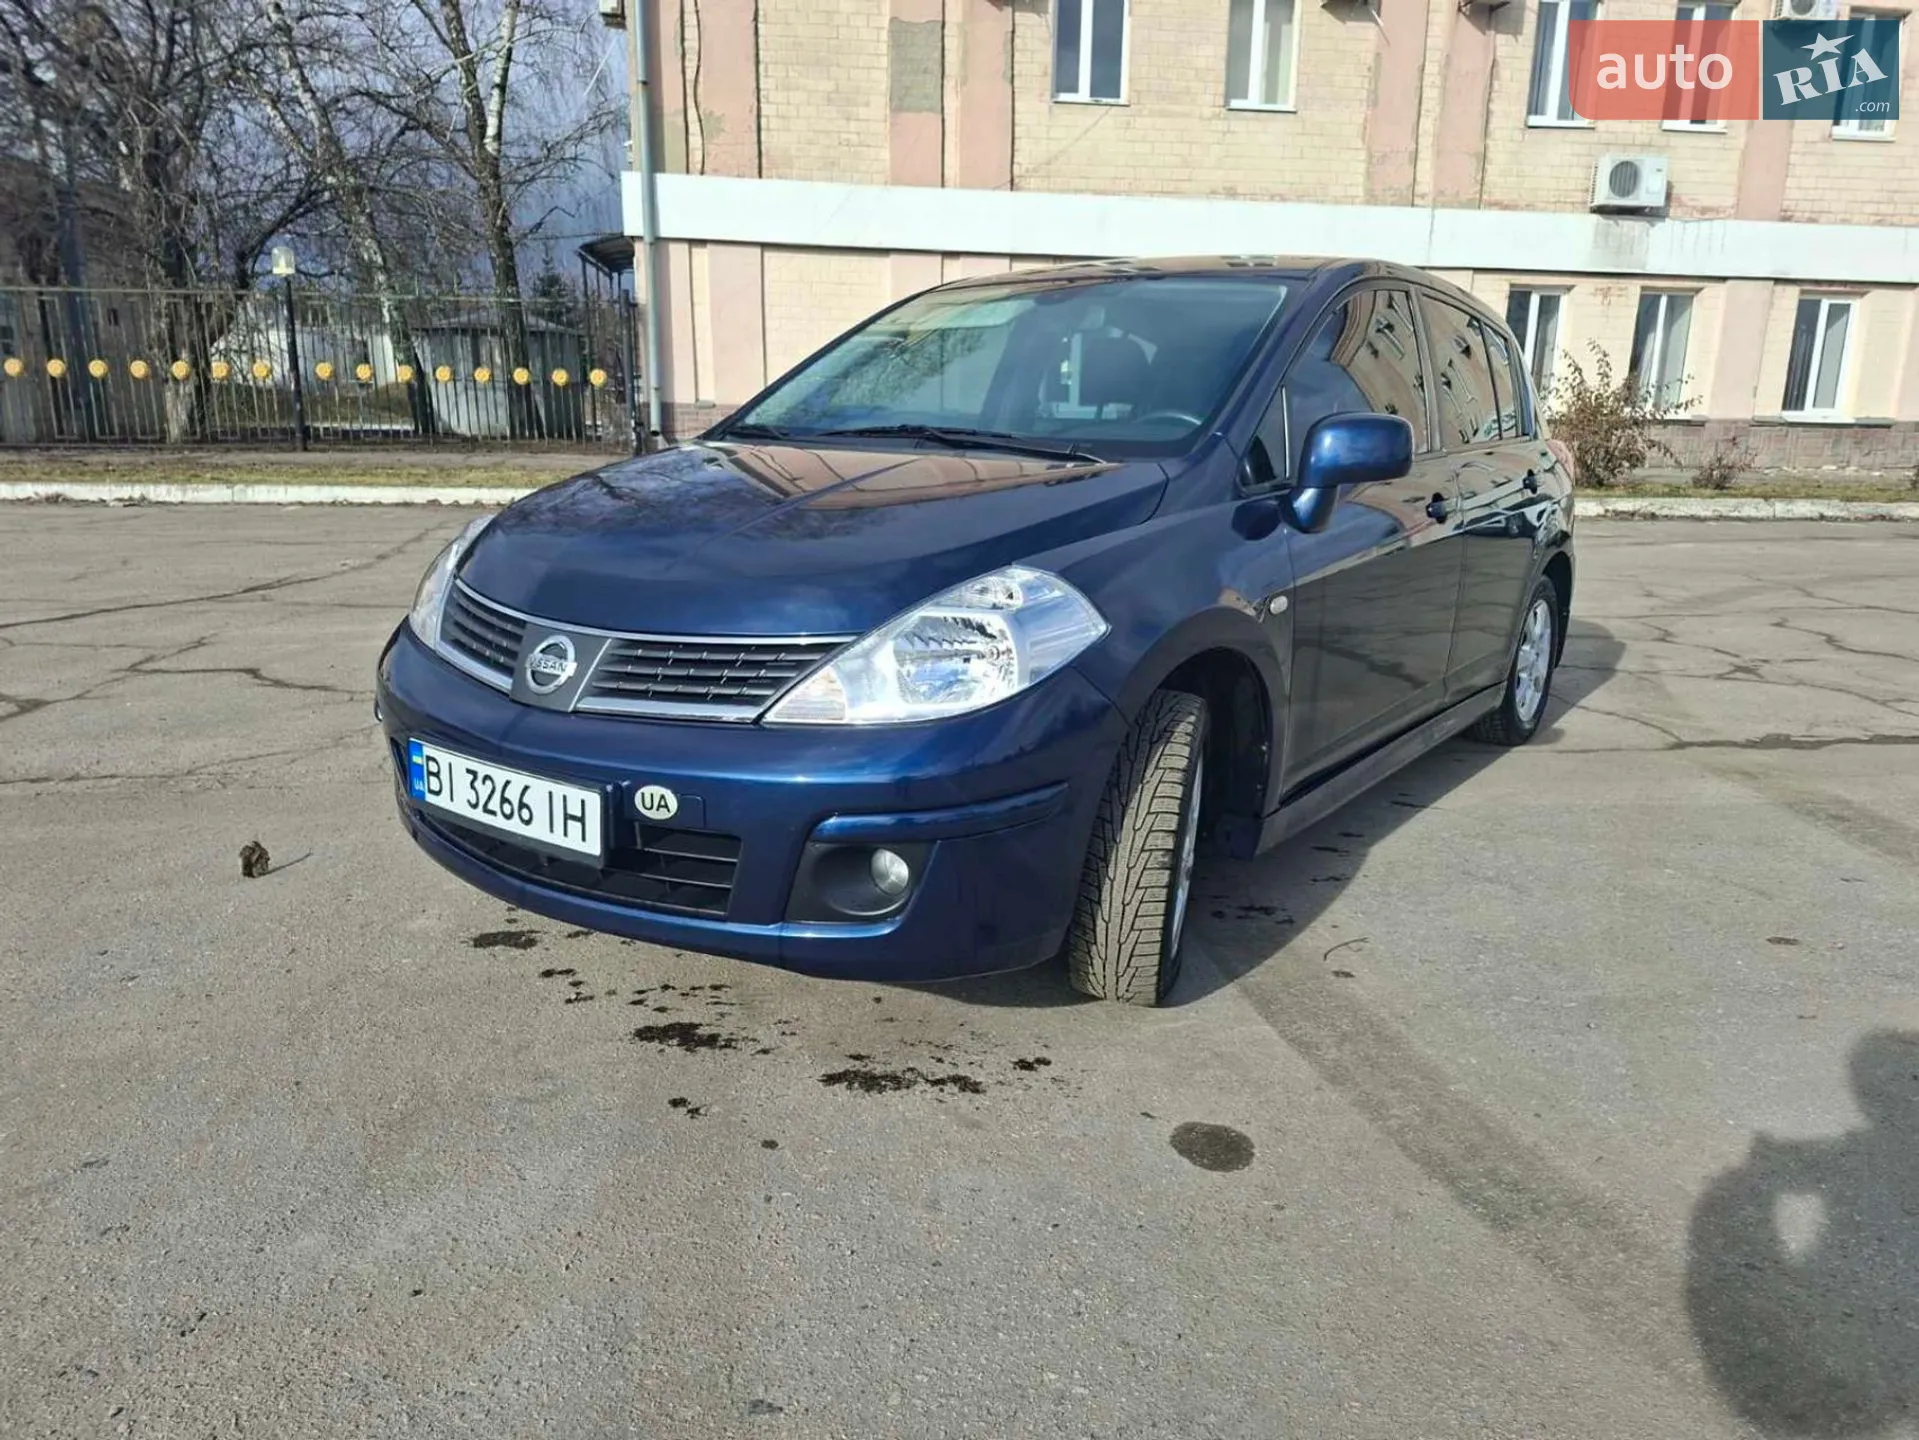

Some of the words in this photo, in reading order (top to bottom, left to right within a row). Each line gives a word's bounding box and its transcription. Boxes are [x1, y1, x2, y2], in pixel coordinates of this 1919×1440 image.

[425, 755, 454, 802] BI
[465, 768, 534, 826] 3266
[548, 790, 587, 843] IH
[640, 792, 671, 813] UA
